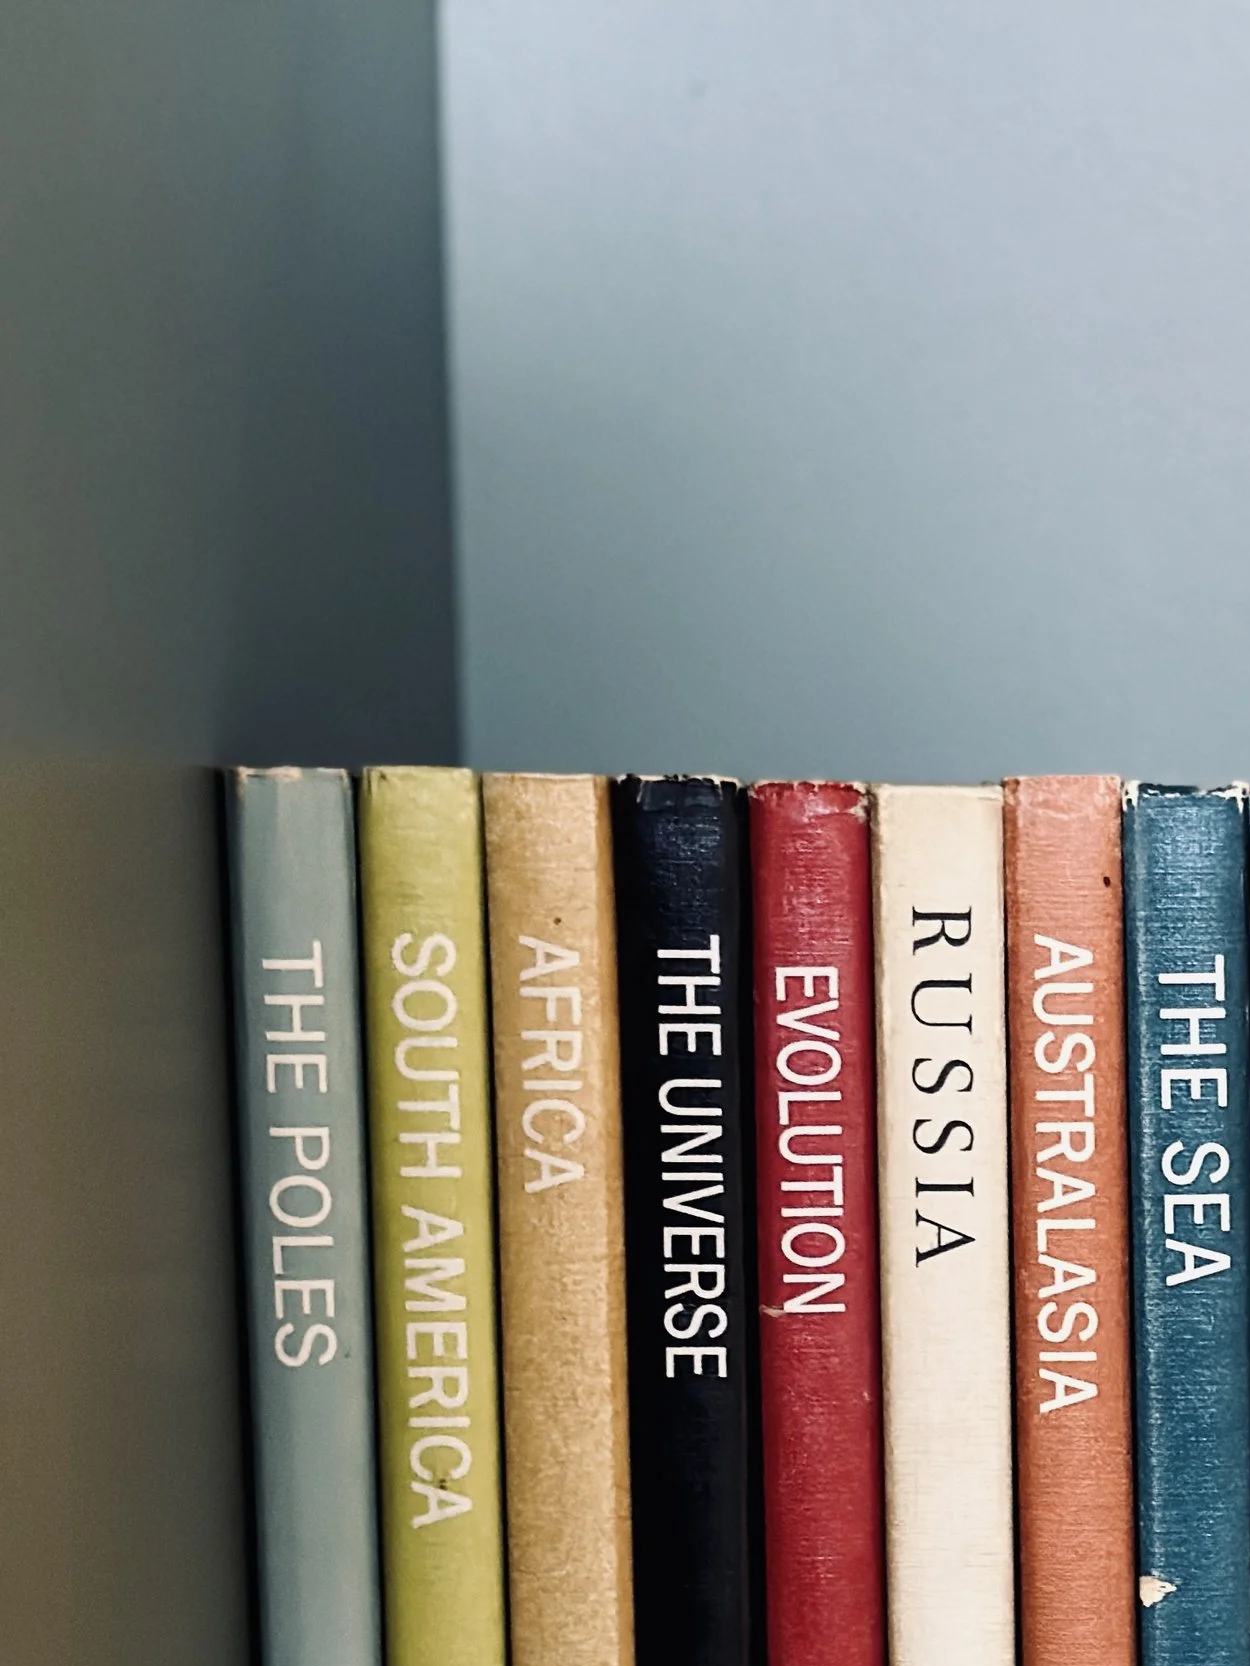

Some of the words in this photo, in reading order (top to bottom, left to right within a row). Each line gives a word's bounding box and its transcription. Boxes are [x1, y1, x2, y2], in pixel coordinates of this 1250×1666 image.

[261, 941, 329, 1095] THE
[390, 932, 461, 1180] SOUTH
[518, 934, 585, 1194] AFRICA
[656, 934, 721, 1056] THE
[910, 904, 977, 1267] RUSSIA
[1156, 954, 1228, 1110] THE
[268, 1125, 337, 1368] POLES
[658, 1077, 728, 1379] UNIVERSE
[775, 965, 846, 1315] EVOLUTION
[1033, 932, 1100, 1415] AUSTRALASIA
[1162, 1141, 1232, 1286] SEA
[400, 1205, 472, 1530] AMERICA
